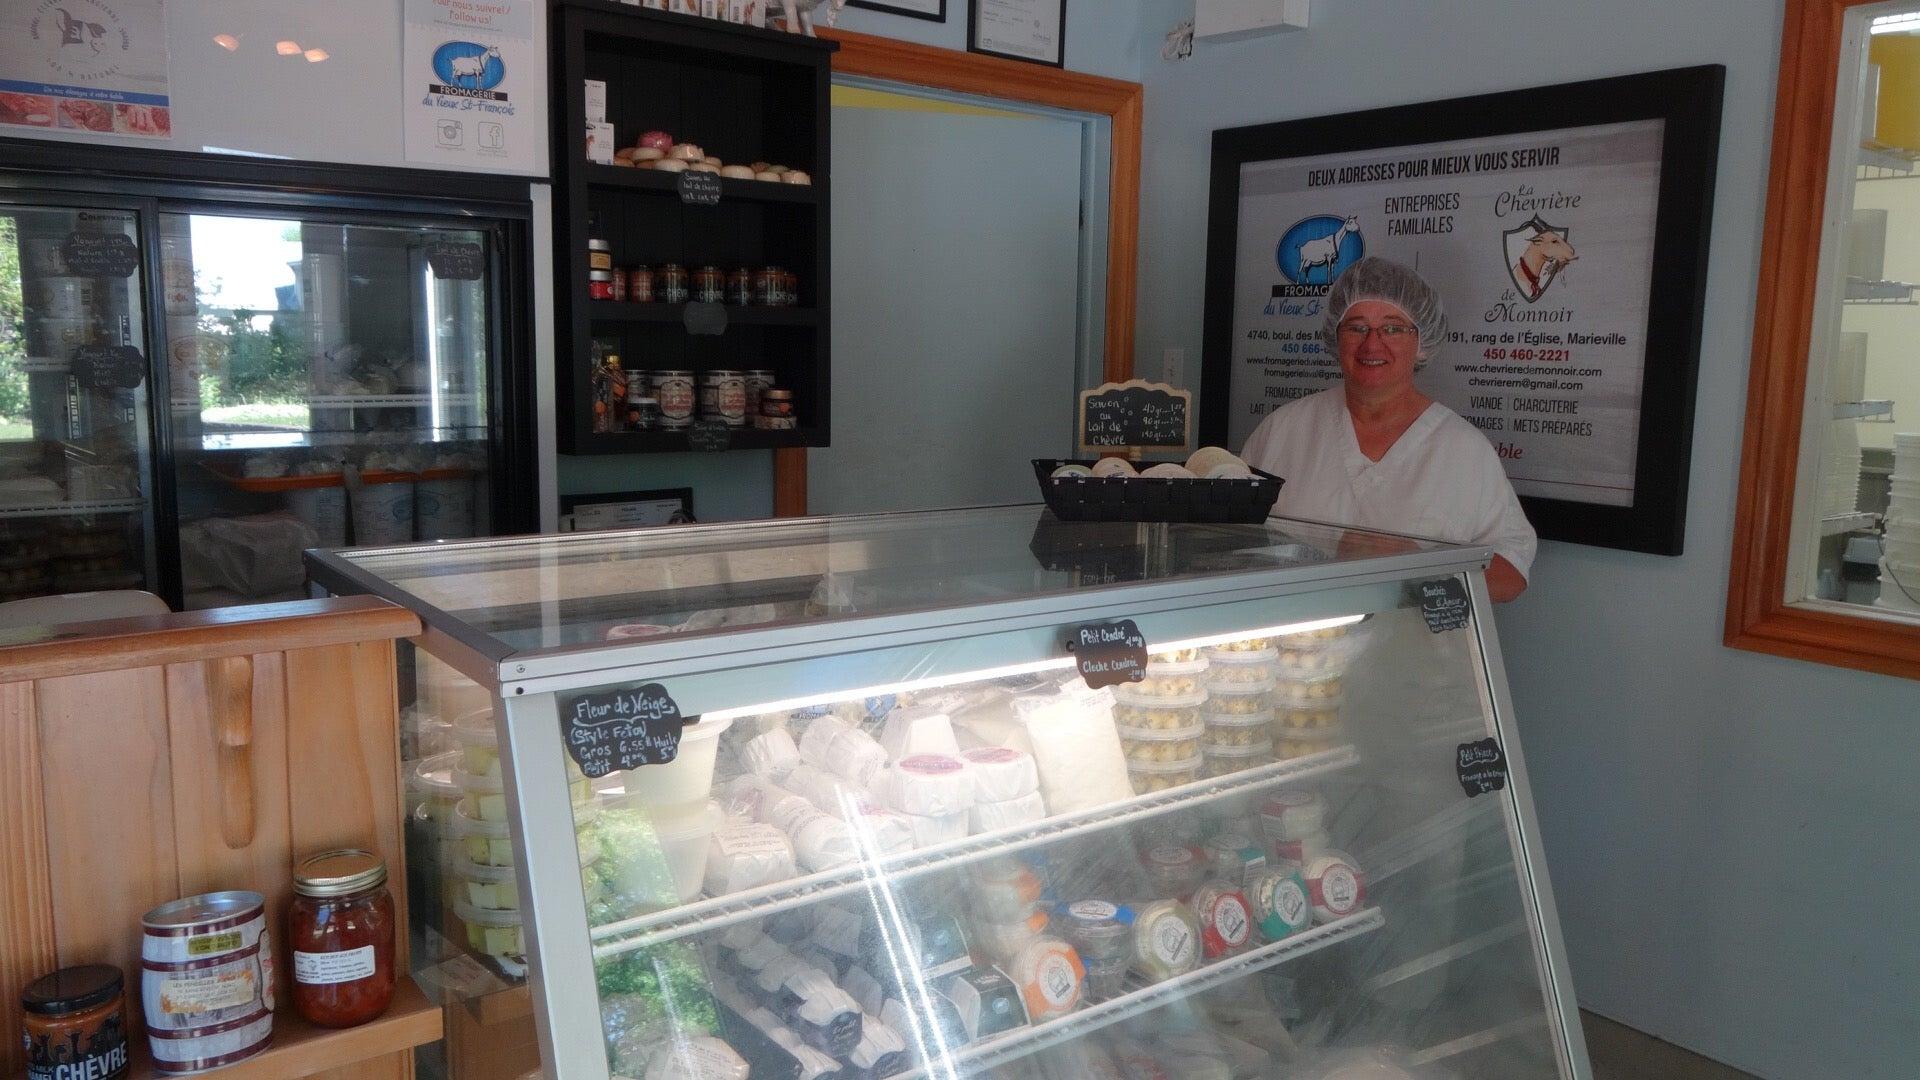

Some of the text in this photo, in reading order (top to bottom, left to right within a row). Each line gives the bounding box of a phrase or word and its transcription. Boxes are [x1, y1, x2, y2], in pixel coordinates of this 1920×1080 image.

[449, 10, 475, 22] Follow
[422, 92, 432, 107] du
[436, 96, 458, 108] Vieux
[440, 86, 496, 100] FROMAGERIE
[1308, 147, 1560, 187] DEUX ADRESSES POUR MIEUX VOUS SERVIR
[1518, 184, 1534, 197] La
[1384, 193, 1460, 214] ENTREPRISES
[1494, 191, 1581, 218] Chevrière
[1387, 216, 1453, 236] FAMILIALES
[1501, 288, 1516, 301] de
[1263, 297, 1275, 316] du
[1279, 298, 1304, 316] Vieux
[1484, 302, 1574, 323] Monnoir
[1247, 330, 1270, 342] 4740,
[1272, 330, 1293, 341] boul.
[1296, 330, 1312, 341] des
[1447, 331, 1468, 344] 191,
[1471, 335, 1497, 346] rang
[1500, 332, 1514, 344] de
[1567, 332, 1627, 345] Marieville
[1281, 343, 1300, 354] 450
[1483, 349, 1570, 362] 450 460-2221
[1454, 364, 1602, 377] www.chevrieredemonnoir.com
[1468, 377, 1583, 391] chevrierem@gmail.com
[1264, 386, 1302, 399] FROMAGES
[1250, 404, 1264, 415] LAIT
[1470, 396, 1578, 414] VIANDE CHARCUTERIE
[1100, 412, 1111, 420] au
[1109, 421, 1122, 432] de
[1513, 419, 1539, 433] METS
[1080, 626, 1125, 646] Petit Cendré
[1083, 660, 1109, 673] Cloche
[577, 699, 612, 719] Fleur
[614, 696, 631, 714] de
[580, 745, 612, 760] Gros
[584, 759, 612, 775] Petit
[55, 1039, 128, 1080] CHÈVRE
